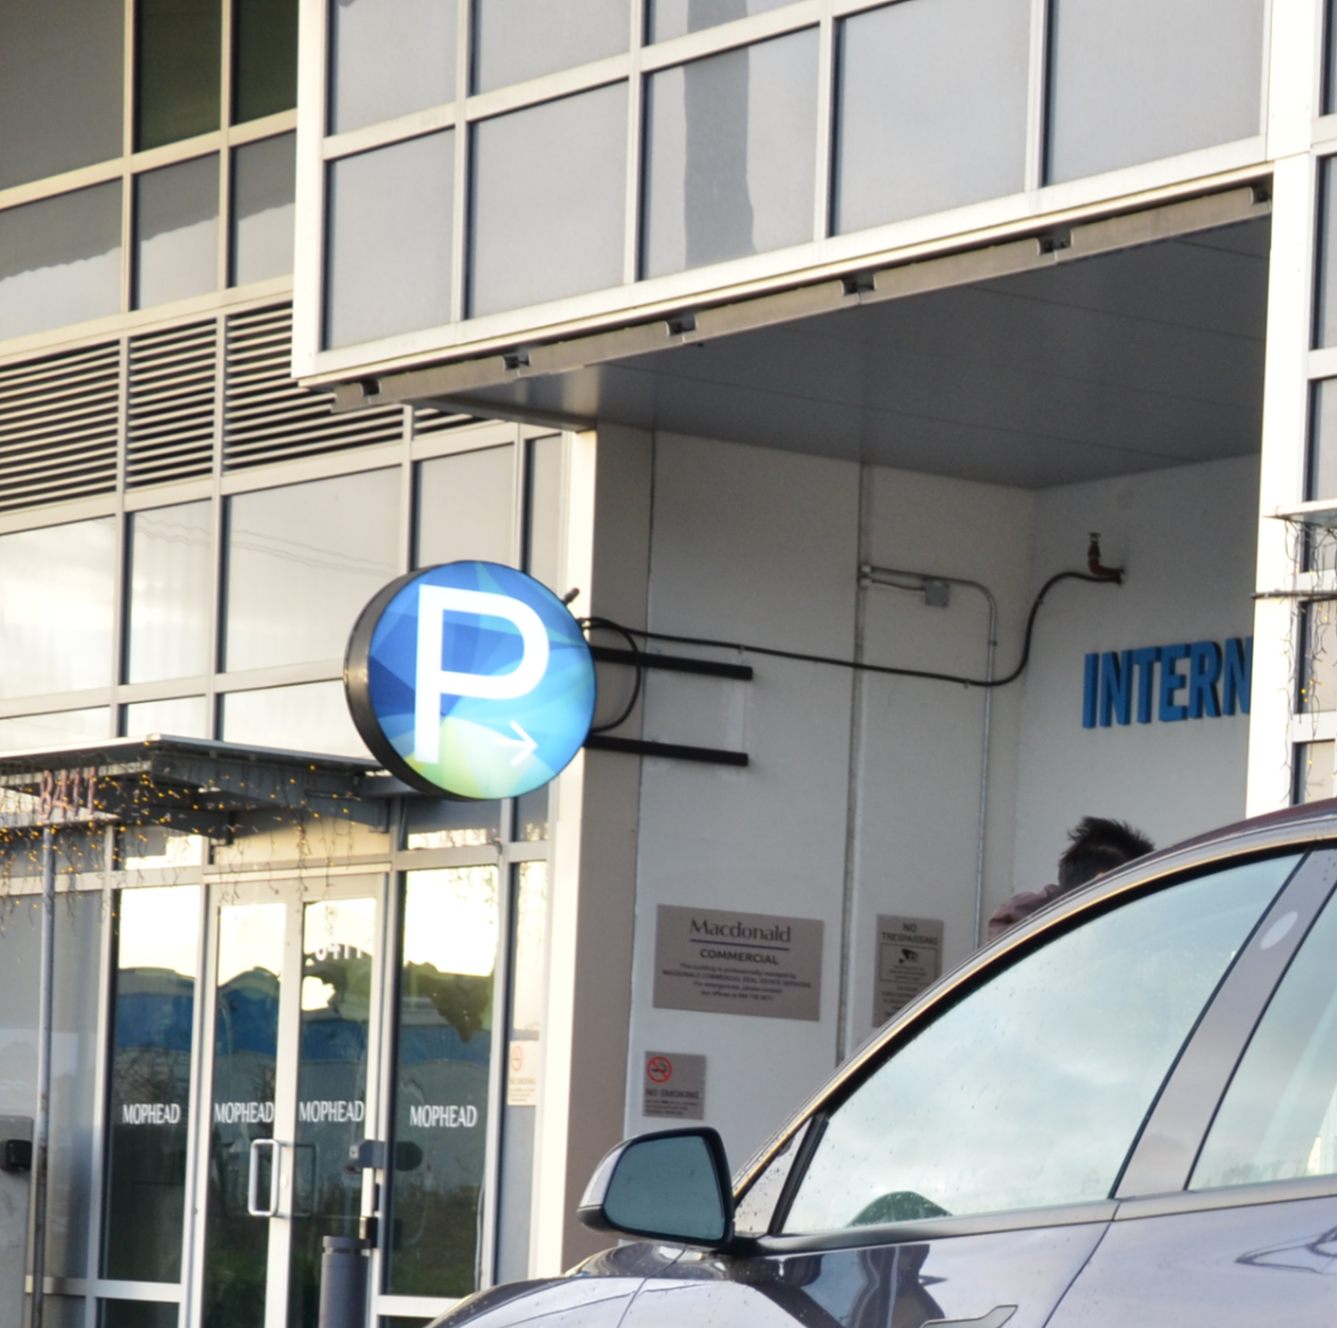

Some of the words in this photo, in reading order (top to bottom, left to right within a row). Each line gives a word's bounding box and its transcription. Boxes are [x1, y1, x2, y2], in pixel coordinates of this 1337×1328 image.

[414, 584, 550, 764] P
[1082, 633, 1253, 728] INTERN
[690, 918, 791, 943] Macdonald
[903, 922, 918, 932] NO
[700, 949, 779, 965] COMMERCIAL
[122, 1103, 181, 1124] MOPHEAD
[214, 1102, 274, 1123] MOPHEAD
[299, 1100, 365, 1122] MOPHEAD
[410, 1105, 477, 1128] MOPHEAD
